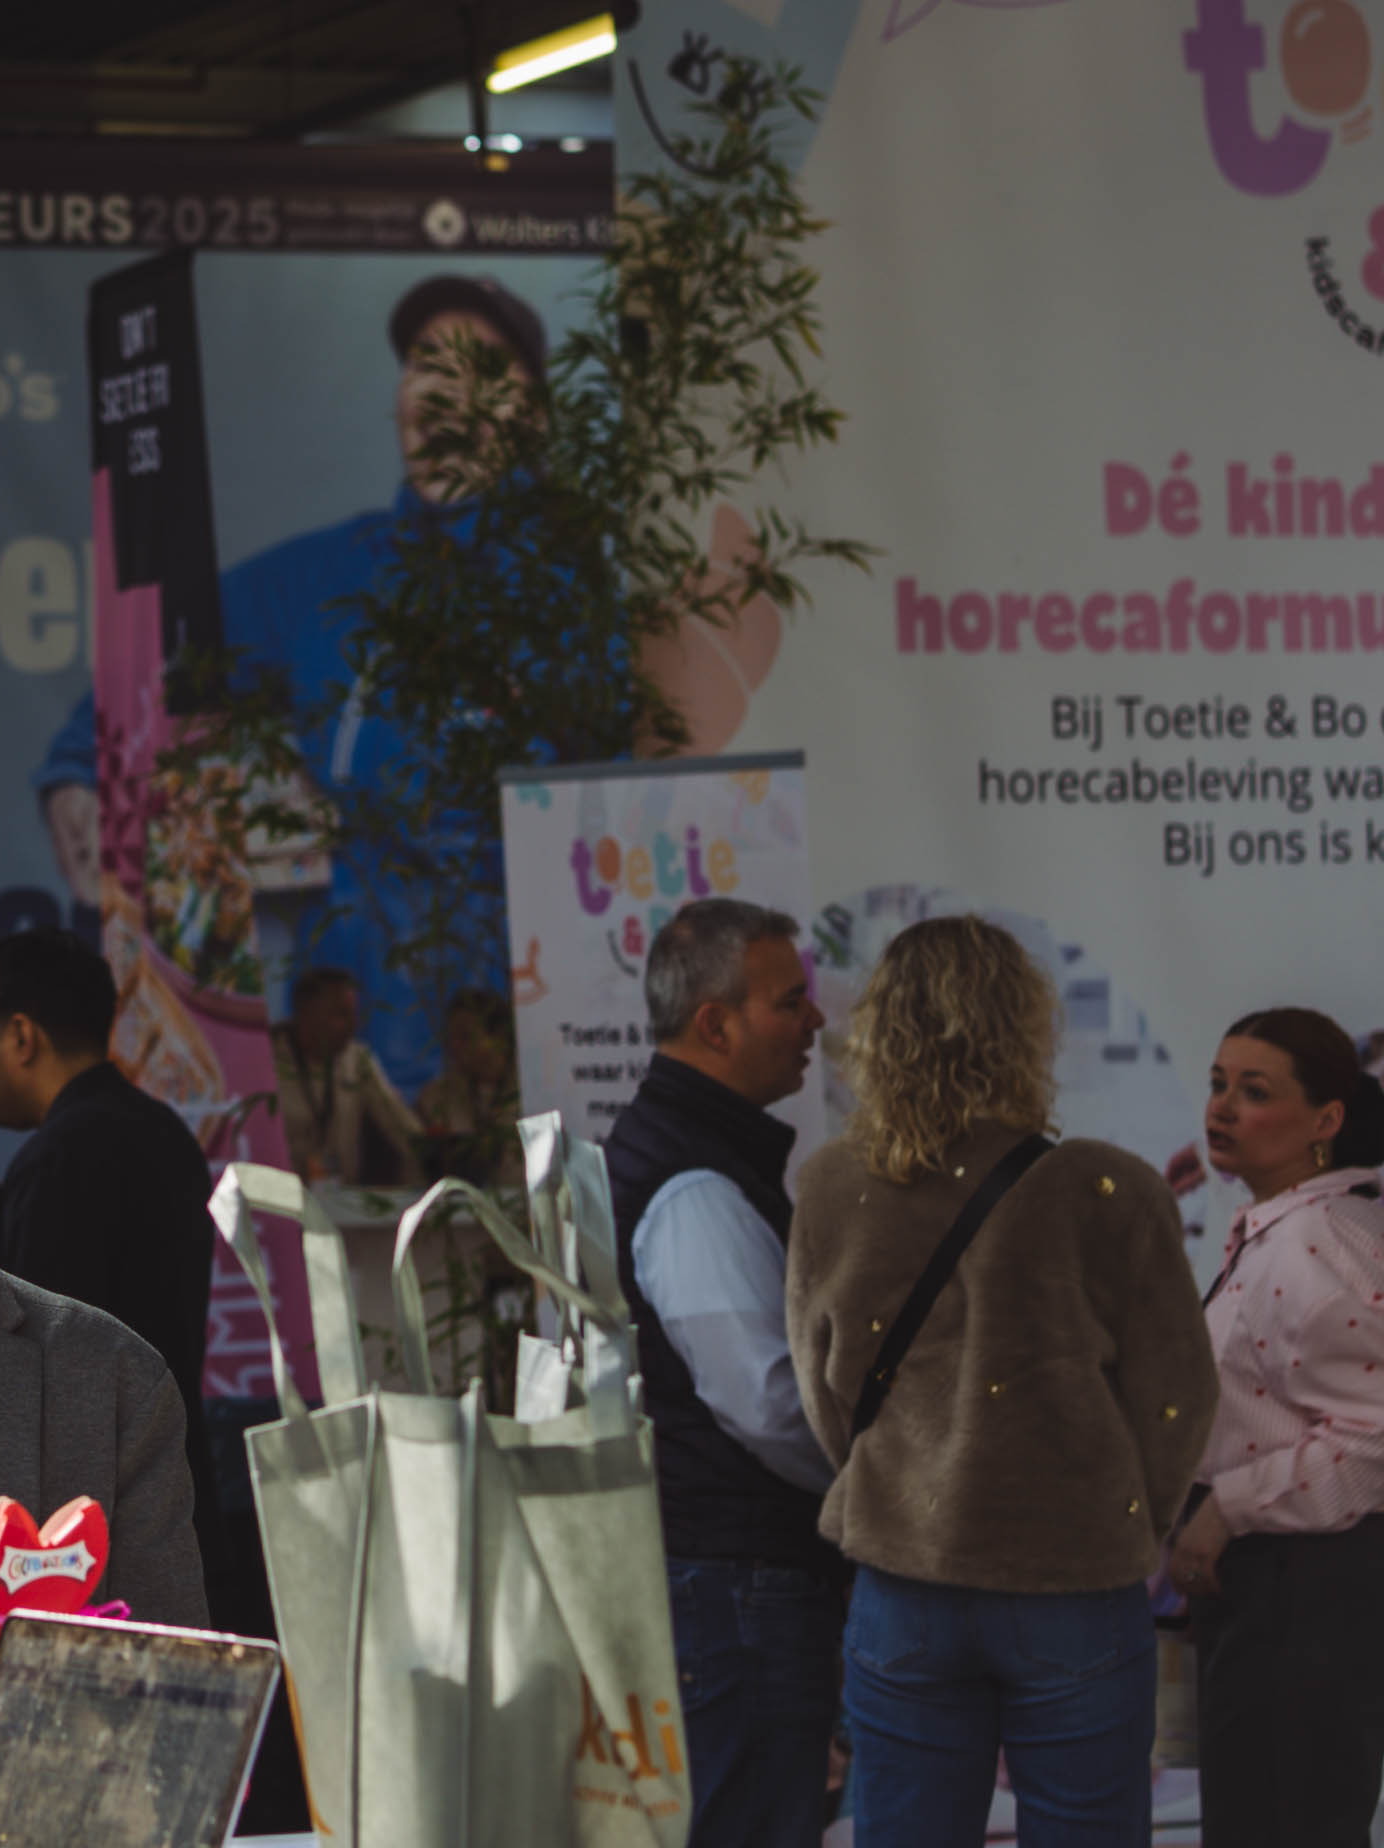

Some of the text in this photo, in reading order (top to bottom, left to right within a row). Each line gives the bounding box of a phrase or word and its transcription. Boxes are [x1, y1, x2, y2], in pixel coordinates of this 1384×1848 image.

[1101, 448, 1204, 539] Dé
[1050, 693, 1369, 754] Bij Toetie & Bo
[977, 757, 1315, 813] horecabeleving
[1162, 820, 1216, 878] Bij
[1227, 829, 1308, 867] ons
[1319, 819, 1353, 865] is
